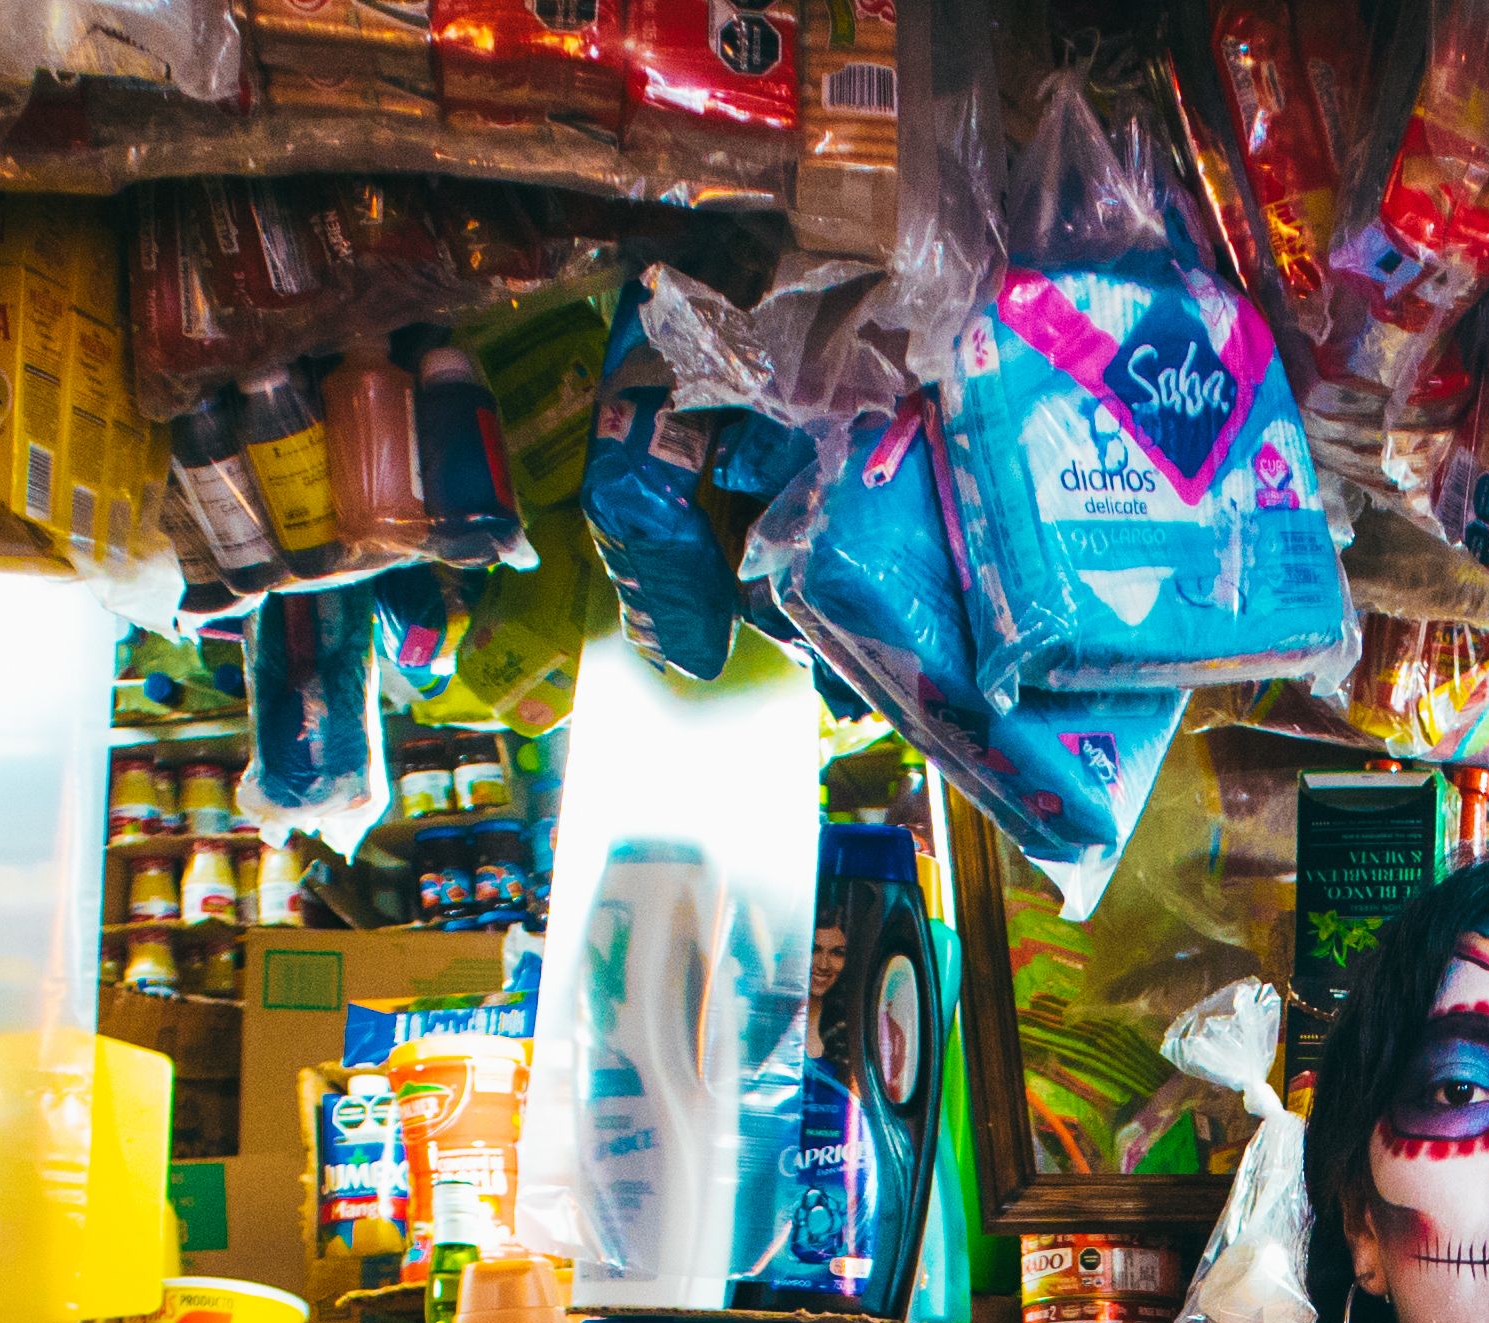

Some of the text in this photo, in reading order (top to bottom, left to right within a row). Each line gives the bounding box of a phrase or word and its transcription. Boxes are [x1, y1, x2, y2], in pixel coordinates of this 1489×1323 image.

[1127, 344, 1231, 415] Saba
[1061, 460, 1157, 494] diarios
[1084, 498, 1148, 516] delicate
[323, 1158, 410, 1198] JUMEX
